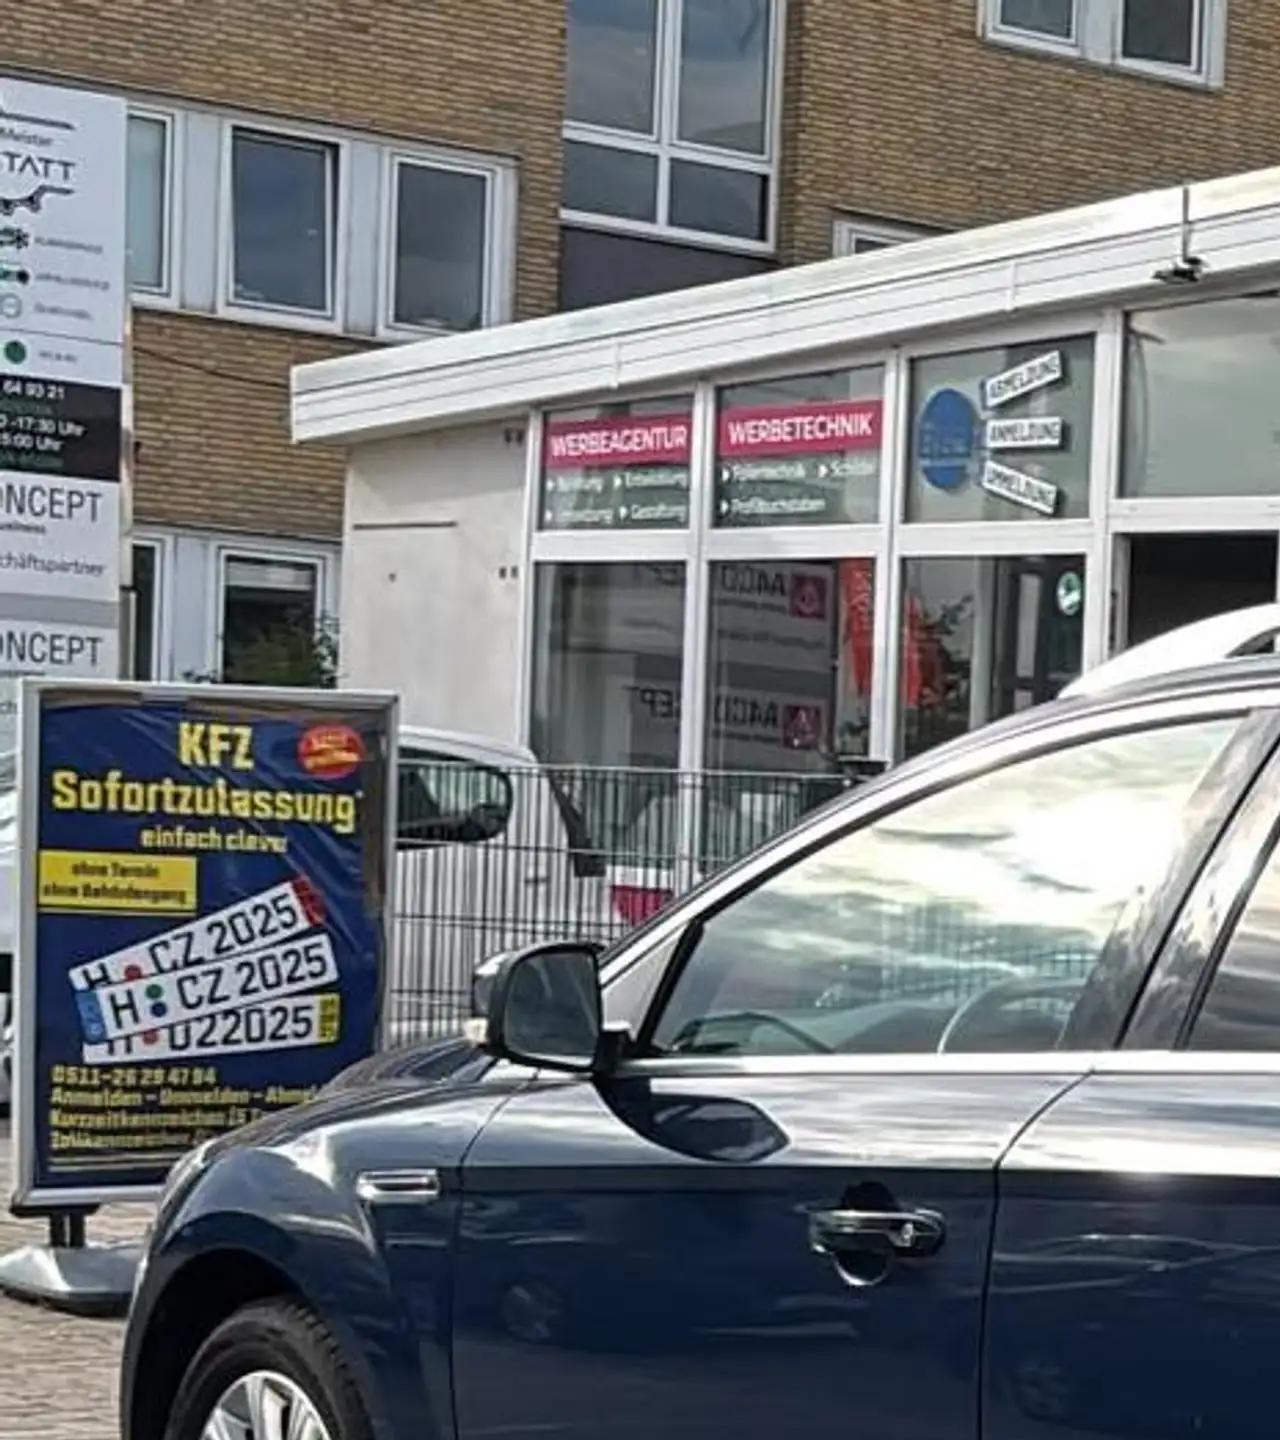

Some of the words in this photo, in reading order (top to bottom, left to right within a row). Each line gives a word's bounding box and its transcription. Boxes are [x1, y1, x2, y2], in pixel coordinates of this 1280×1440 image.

[0, 151, 76, 182] TATT
[35, 435, 63, 452] Uhr
[58, 419, 86, 437] Uhr
[550, 425, 688, 458] WERBEAGENTUR
[727, 411, 875, 446] WERBETECHNIK
[0, 482, 104, 523] NCEPT
[0, 630, 104, 668] NCEPT
[177, 721, 256, 771] KFZ
[51, 769, 357, 834] Sofortzulassung
[140, 825, 221, 850] einfach
[149, 930, 204, 974] CZ
[206, 892, 298, 953] 2025
[108, 988, 140, 1030] H
[175, 968, 230, 1010] CZ
[233, 942, 329, 996] 2025
